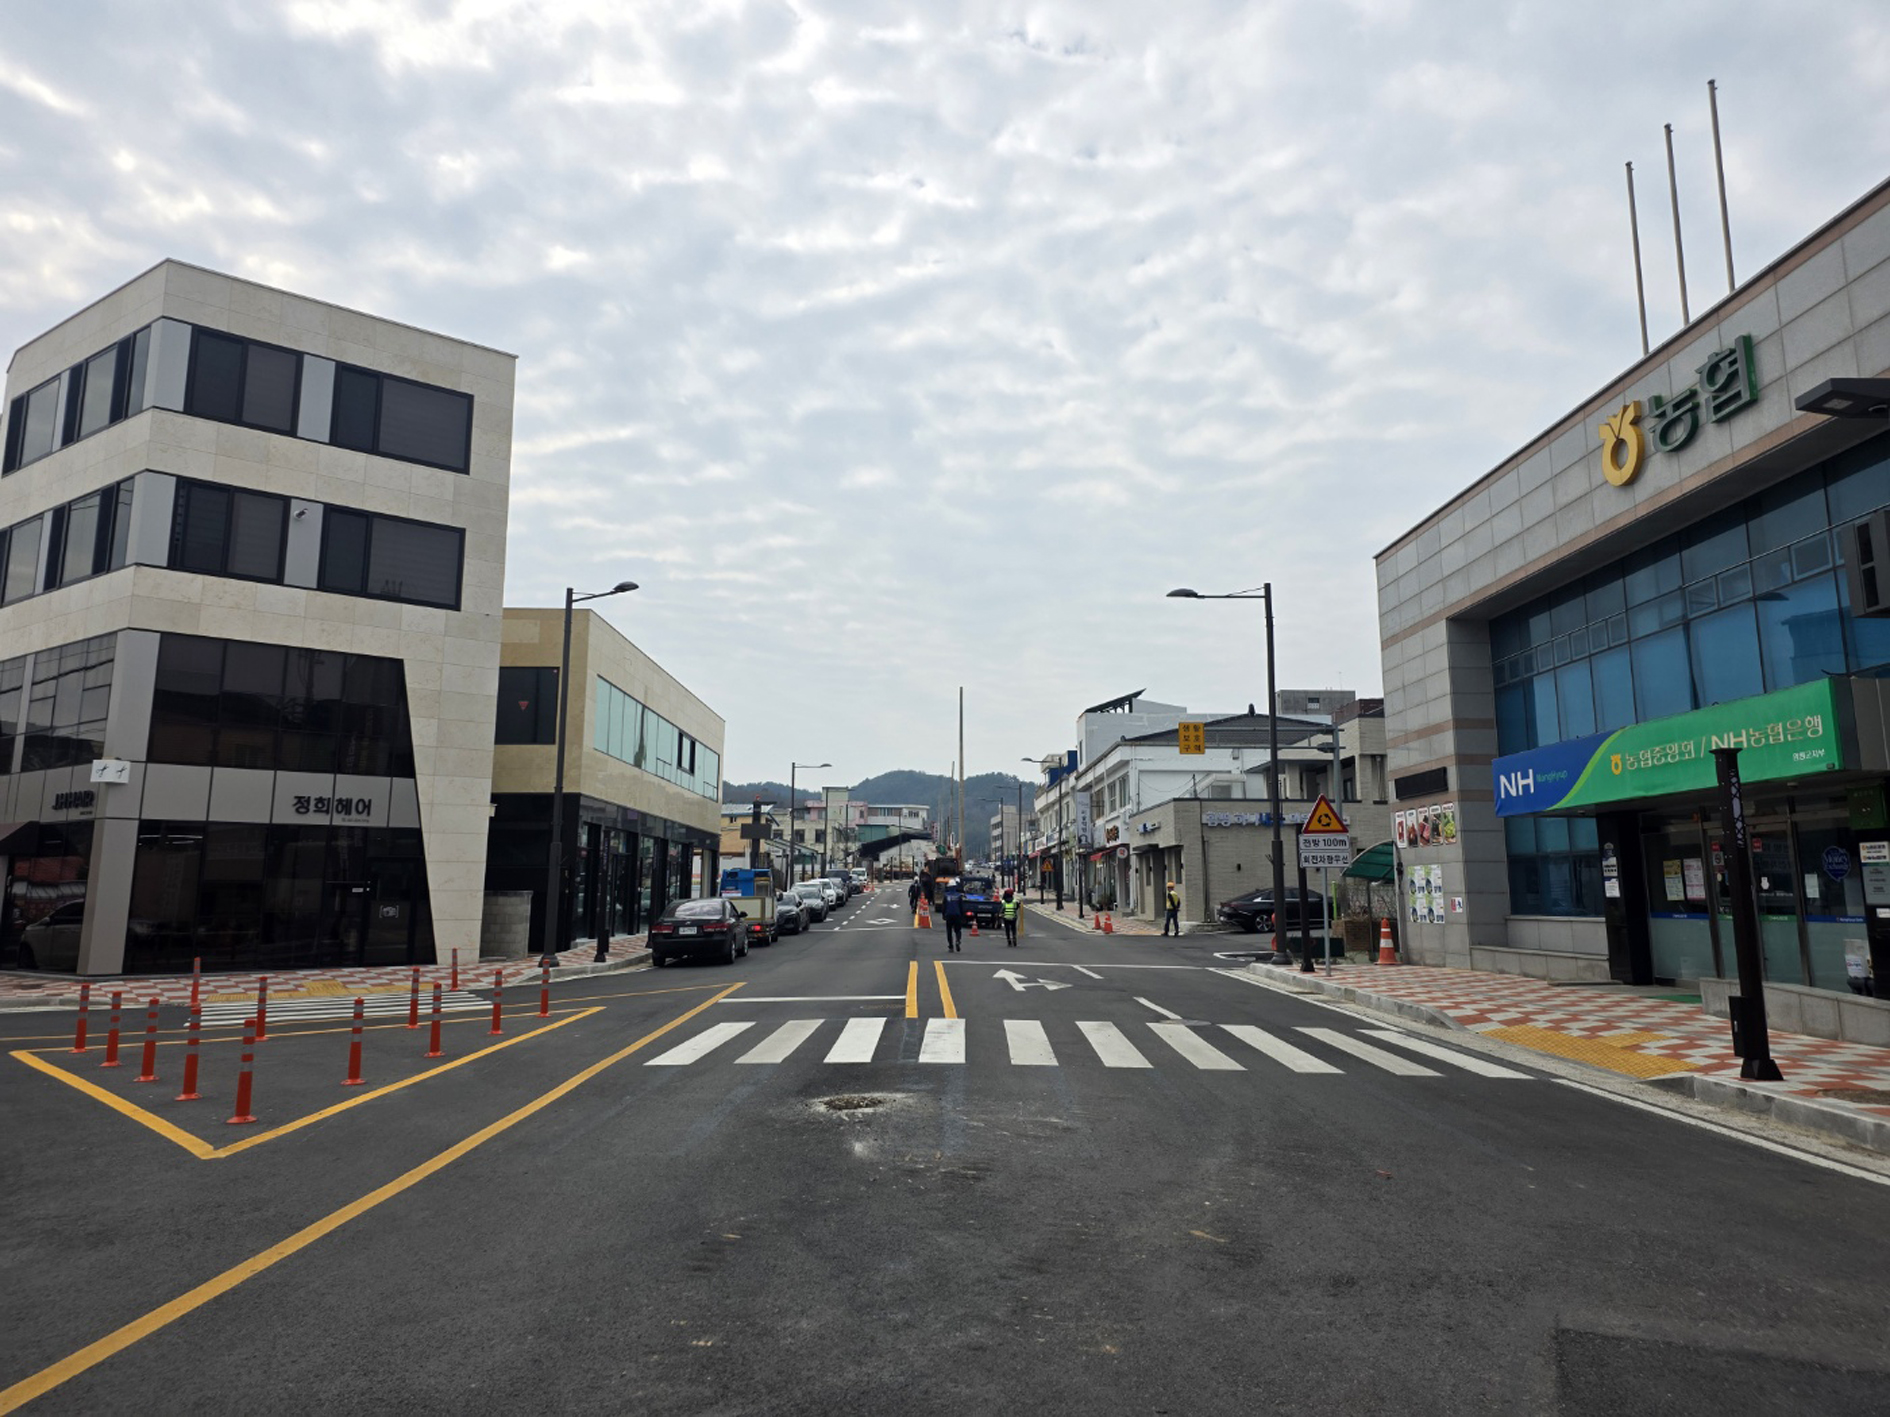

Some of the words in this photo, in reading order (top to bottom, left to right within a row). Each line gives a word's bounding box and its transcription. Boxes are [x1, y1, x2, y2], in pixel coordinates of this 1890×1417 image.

[1646, 334, 1759, 453] 농협
[1625, 740, 1695, 770] 농협중앙회
[1499, 768, 1535, 799] NH
[292, 796, 372, 817] 정희헤어
[1302, 838, 1320, 848] 전방
[1322, 837, 1347, 847] 100m
